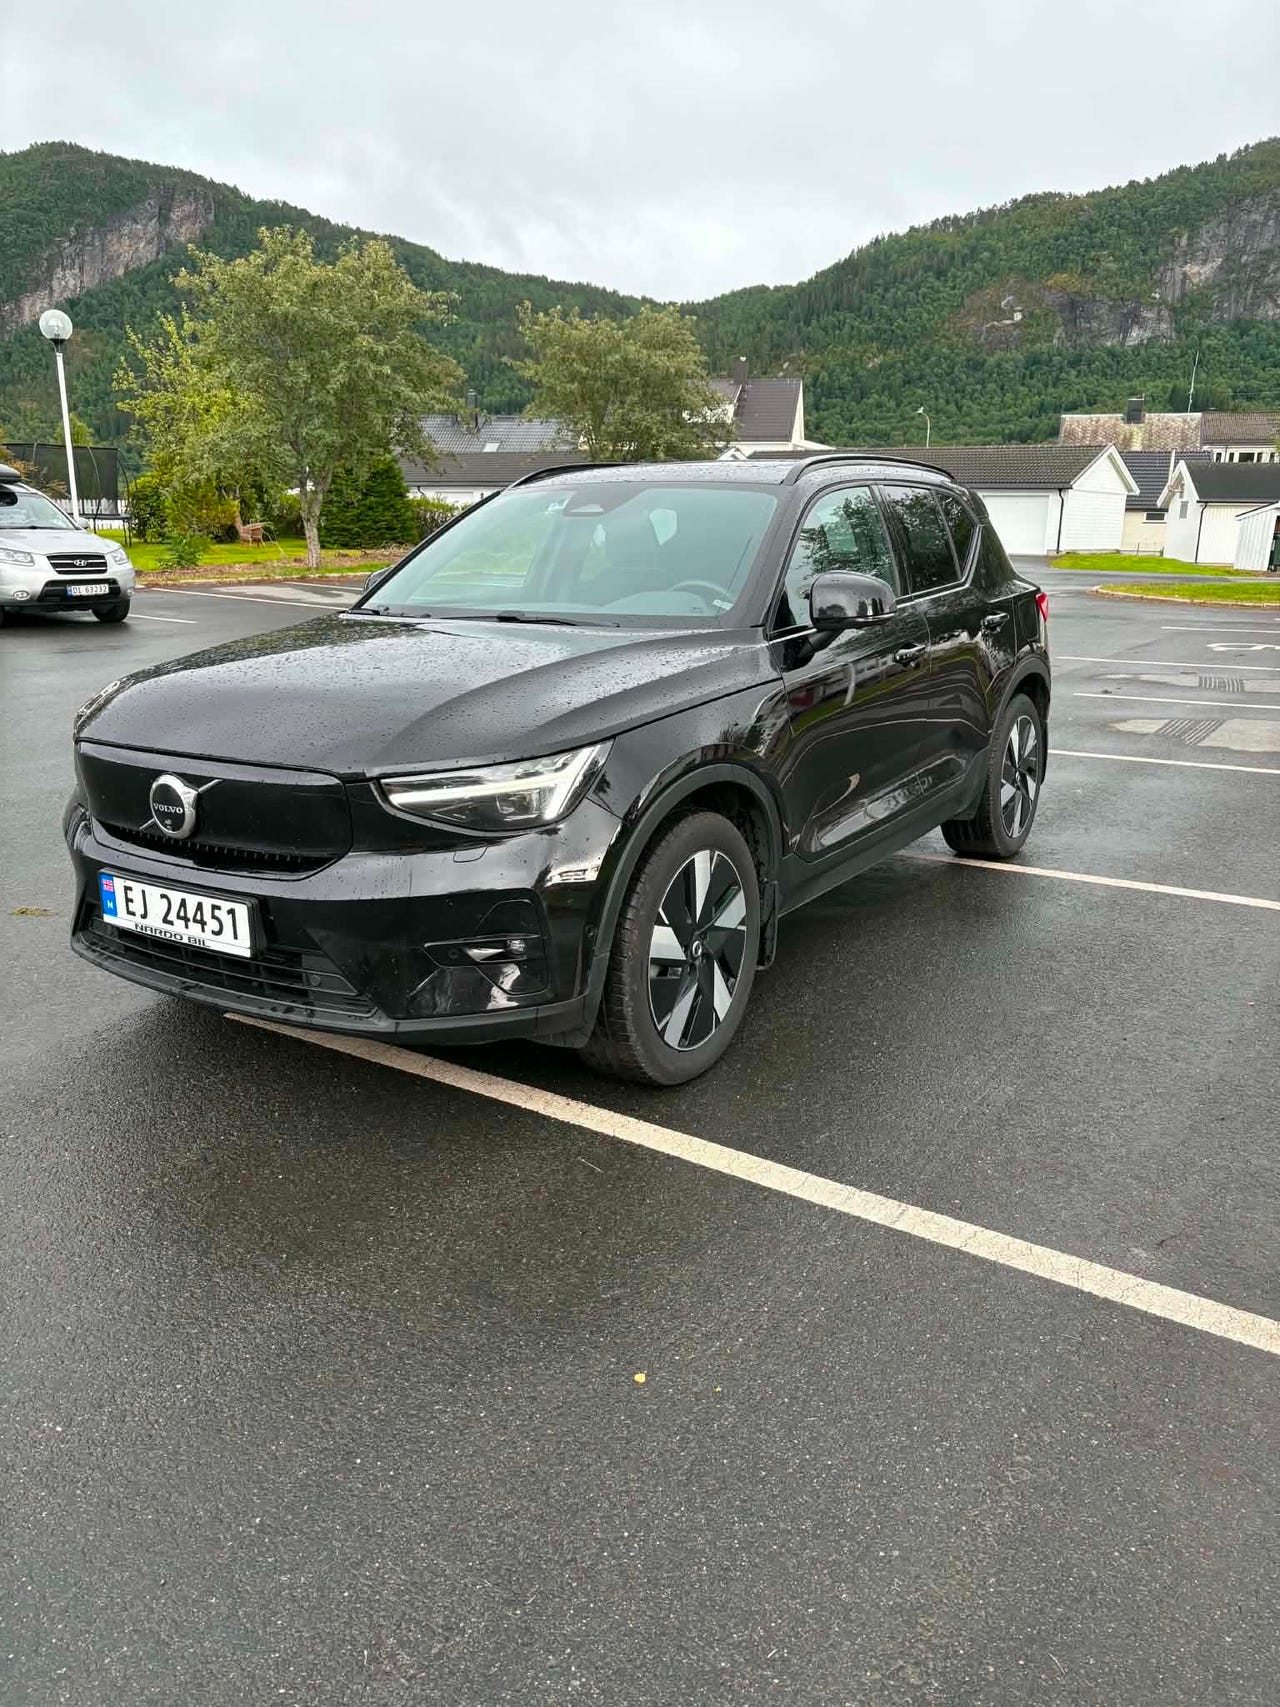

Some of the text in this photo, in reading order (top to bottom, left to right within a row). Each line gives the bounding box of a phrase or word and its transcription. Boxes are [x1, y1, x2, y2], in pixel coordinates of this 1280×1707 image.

[153, 803, 183, 814] VOLVO
[107, 900, 113, 909] N
[123, 885, 238, 940] EJ 24451
[134, 923, 210, 947] NARDO BIL
